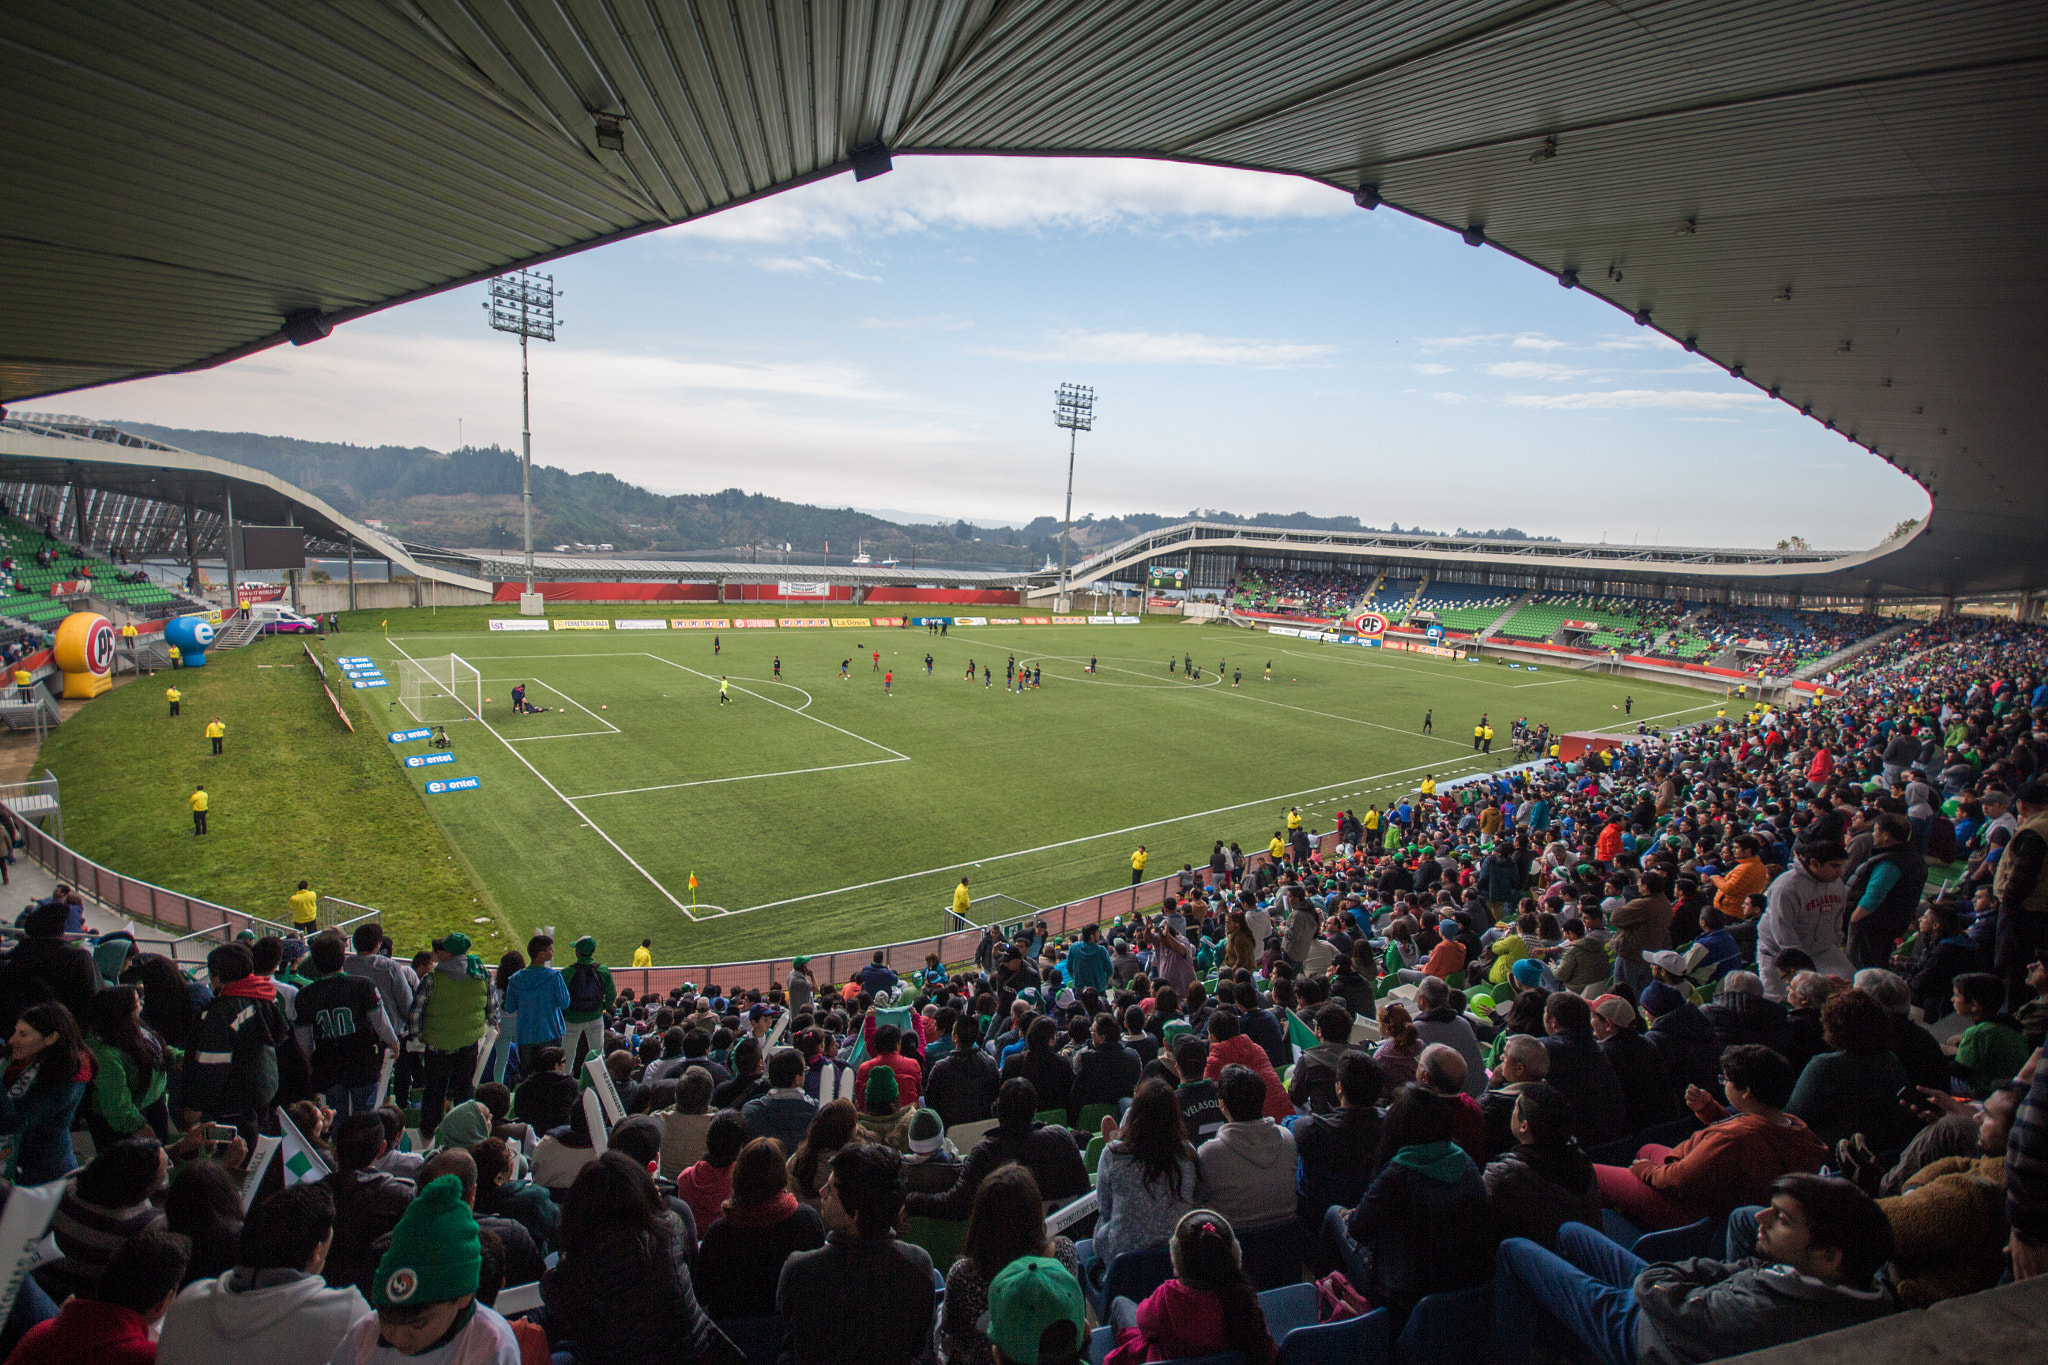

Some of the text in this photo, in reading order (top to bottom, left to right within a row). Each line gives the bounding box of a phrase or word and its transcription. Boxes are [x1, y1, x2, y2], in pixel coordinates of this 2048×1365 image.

[1362, 618, 1378, 632] PF
[97, 627, 113, 664] PF
[407, 729, 430, 739] entel
[426, 754, 453, 764] entel
[448, 778, 478, 789] entel
